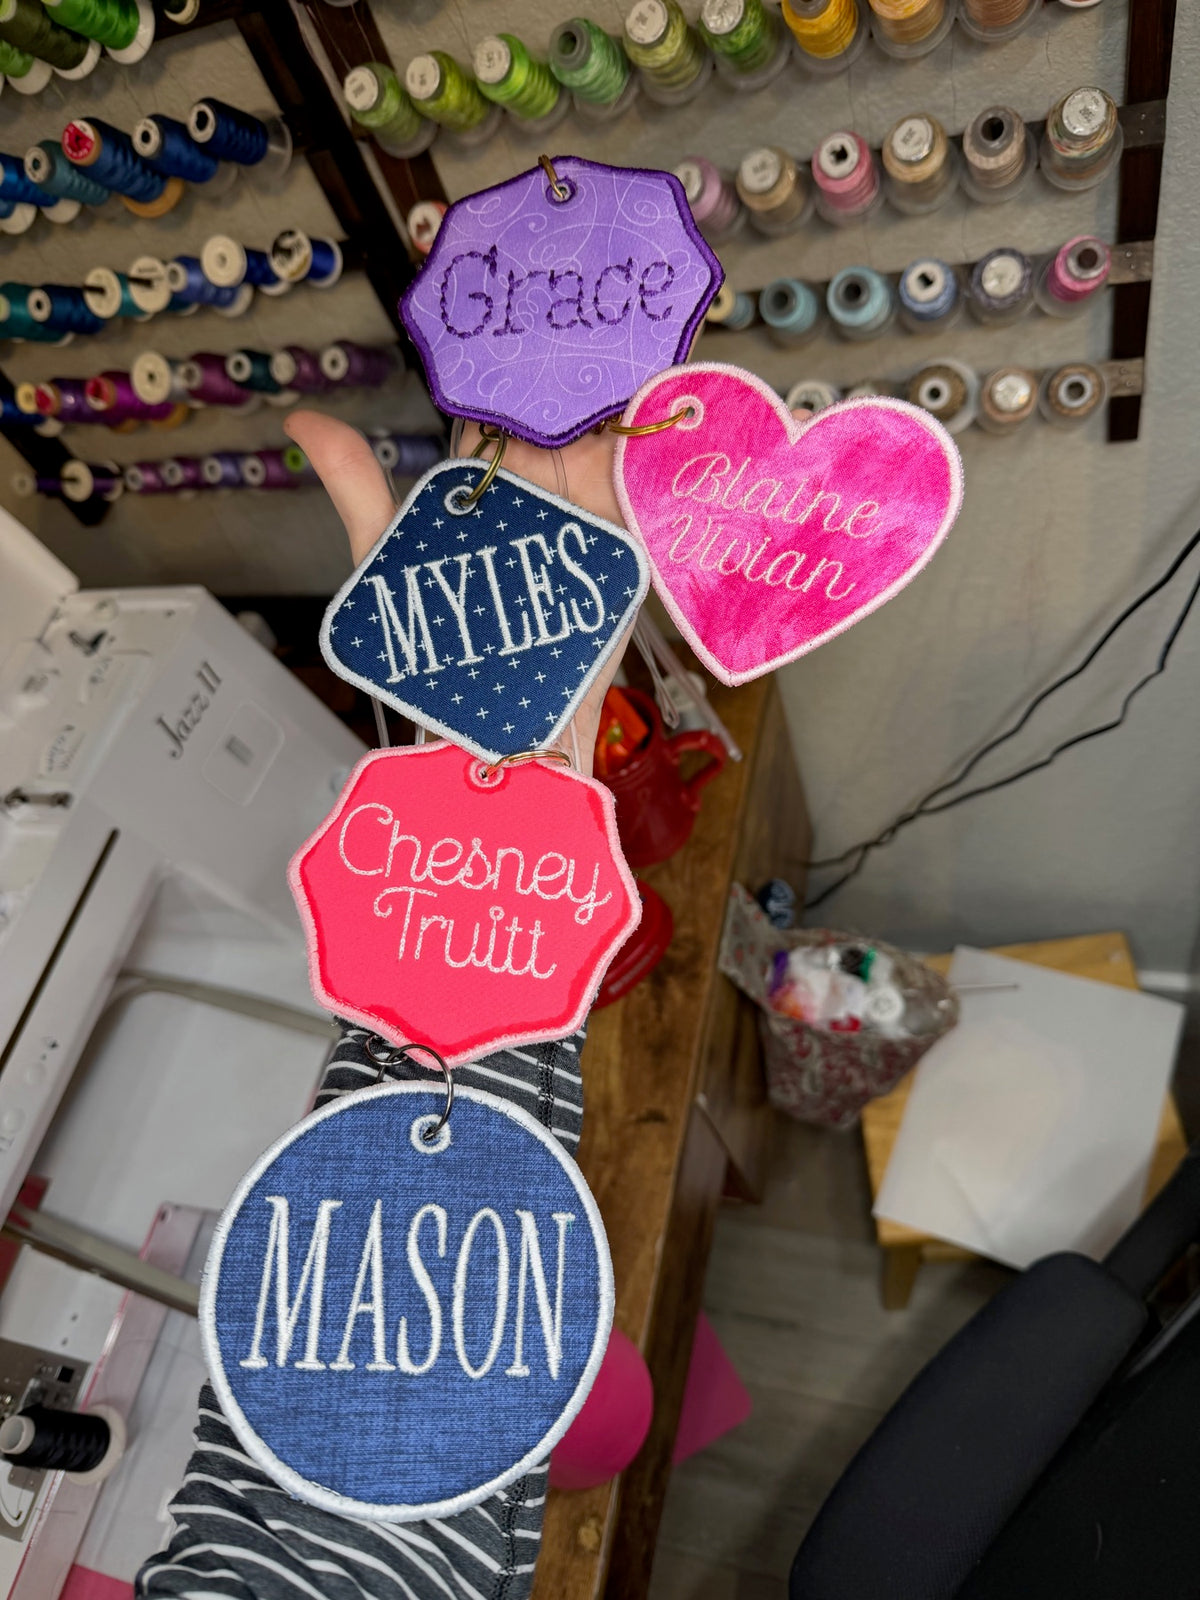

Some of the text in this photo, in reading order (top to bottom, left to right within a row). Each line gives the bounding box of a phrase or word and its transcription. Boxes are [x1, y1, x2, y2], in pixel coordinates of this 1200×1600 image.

[440, 244, 675, 339] Grace
[671, 452, 883, 538] Blaine
[367, 522, 605, 684] MYLES
[668, 514, 856, 600] Vivian
[156, 694, 210, 760] Jazz
[338, 803, 612, 925] Chesney
[373, 886, 557, 979] Truitt
[239, 1196, 576, 1380] MASON
